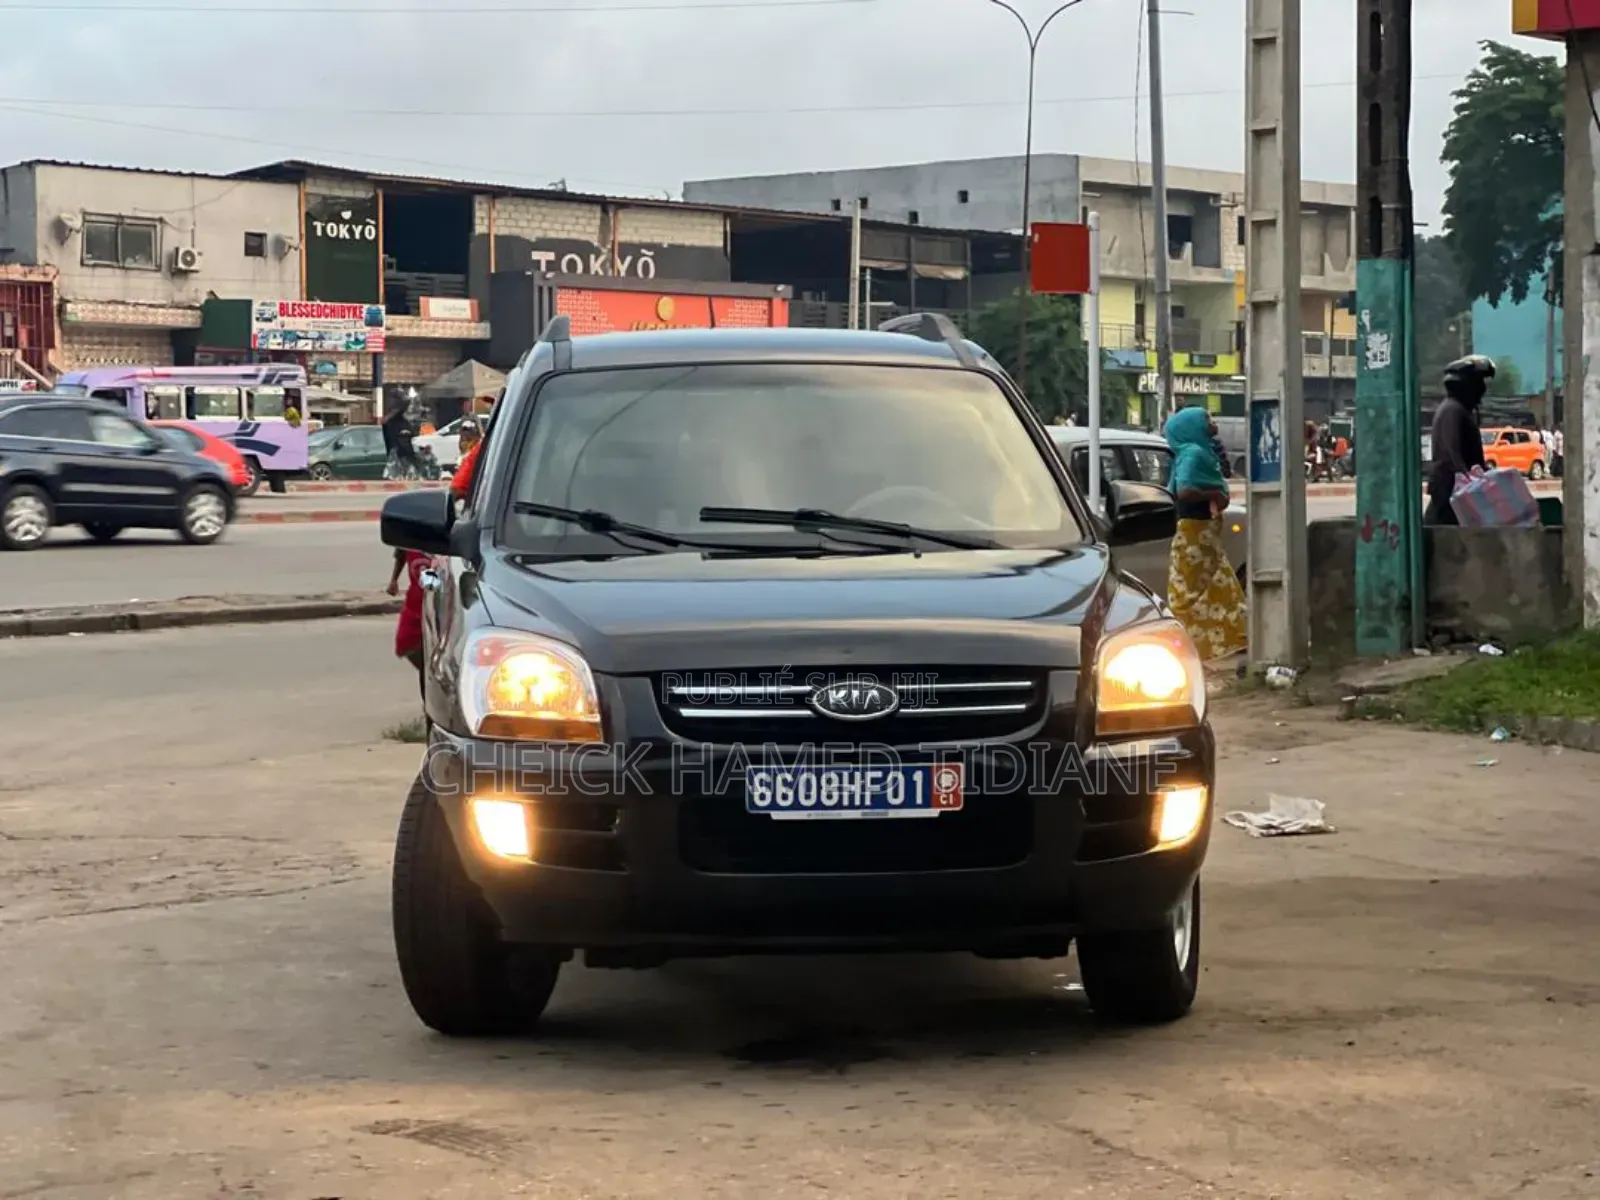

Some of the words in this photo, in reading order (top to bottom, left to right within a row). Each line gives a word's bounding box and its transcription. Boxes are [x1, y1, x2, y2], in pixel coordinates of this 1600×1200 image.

[1138, 373, 1210, 393] PHMACIE
[827, 689, 881, 710] KIA
[939, 793, 954, 805] CI
